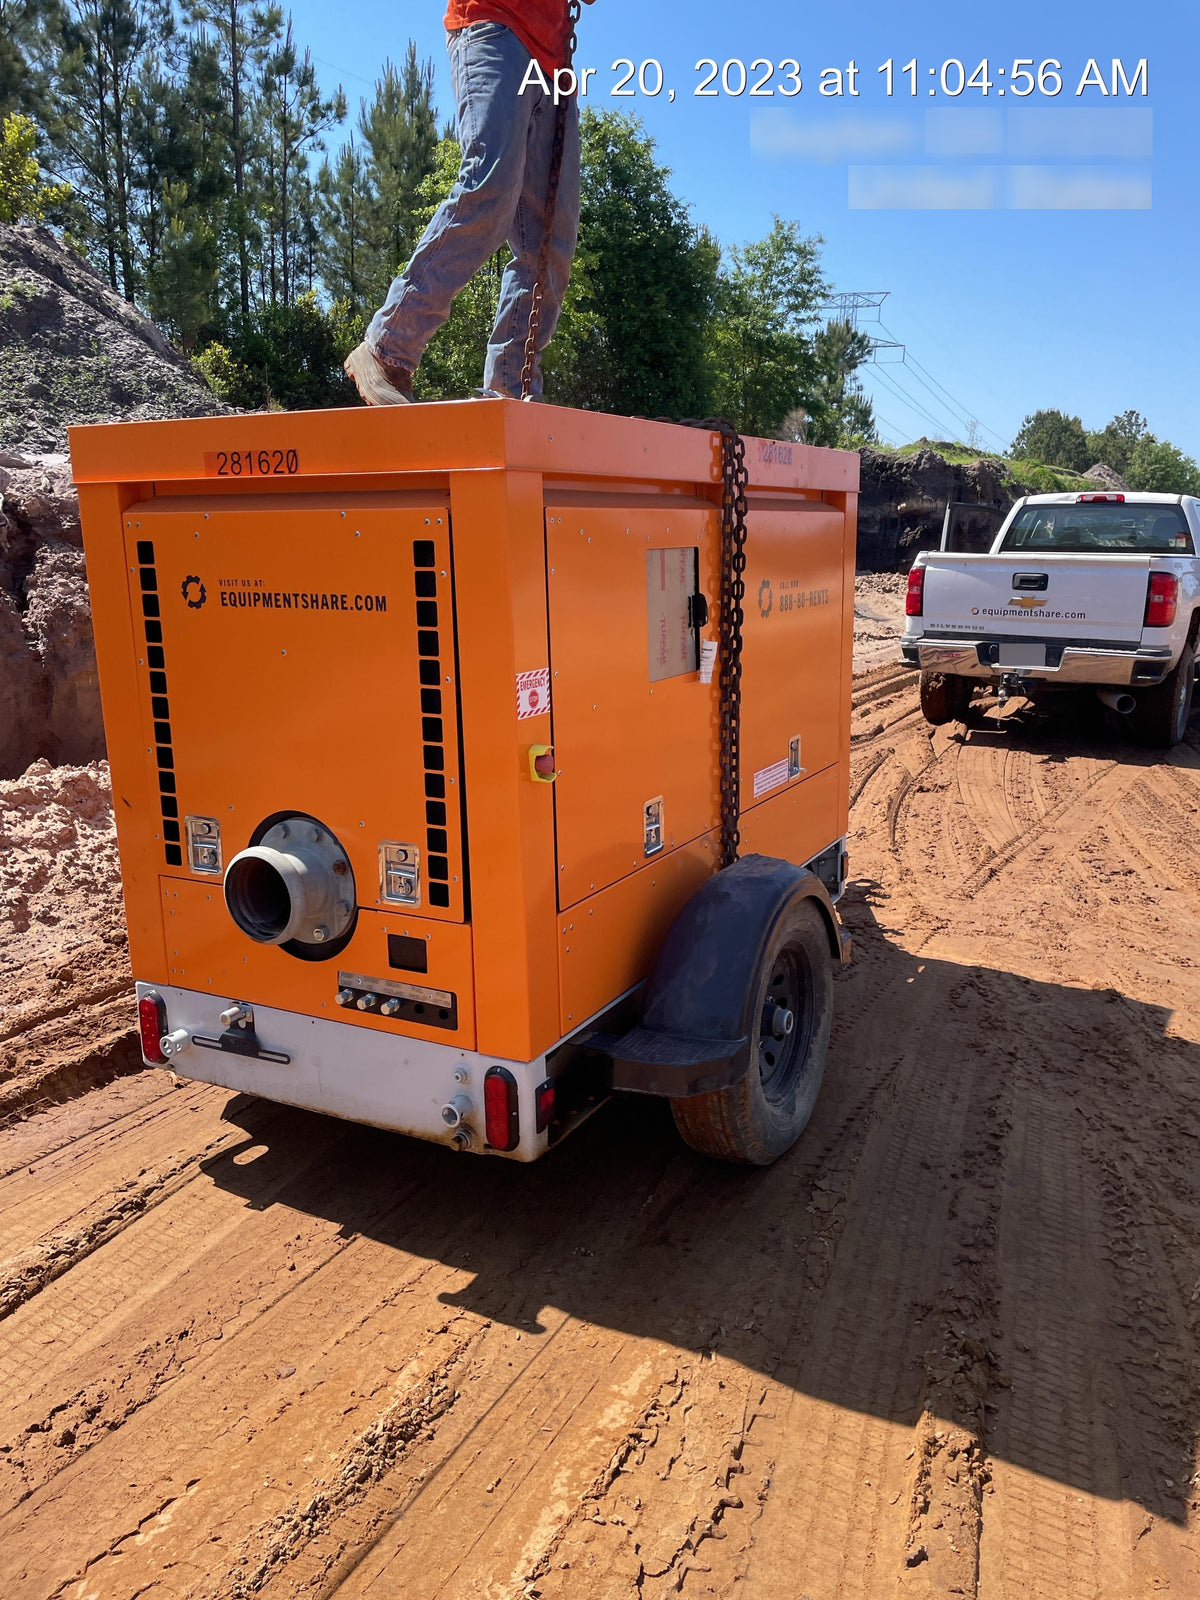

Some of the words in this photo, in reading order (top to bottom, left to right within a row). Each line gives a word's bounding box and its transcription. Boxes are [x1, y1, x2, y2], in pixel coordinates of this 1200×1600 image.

[216, 449, 299, 476] 281620
[219, 579, 238, 588] VISIT
[241, 580, 251, 588] US
[254, 580, 266, 588] AT:
[221, 591, 387, 612] EQUIPMENTSHARE.COM
[982, 607, 1086, 621] equipmentshare.com
[520, 677, 546, 691] EMERGENCY
